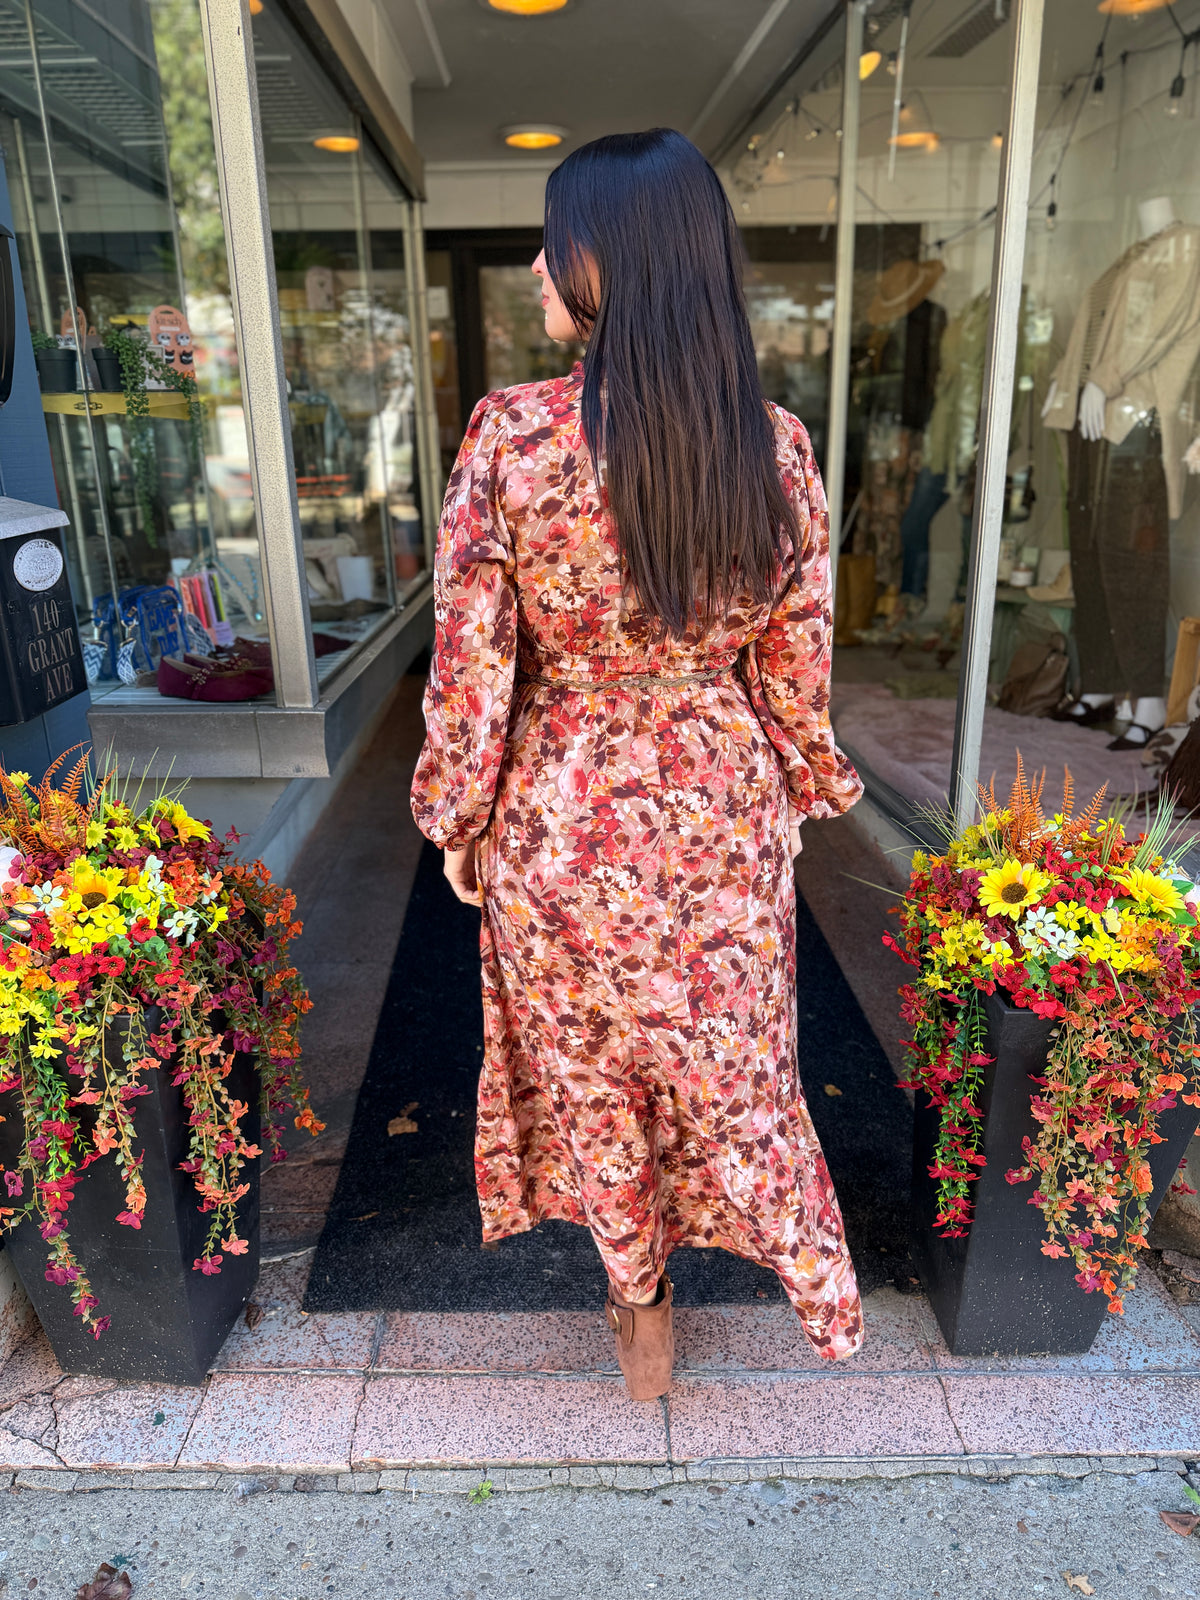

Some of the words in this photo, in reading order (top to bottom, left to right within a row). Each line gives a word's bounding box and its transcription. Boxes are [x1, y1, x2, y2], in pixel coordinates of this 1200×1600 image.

[32, 599, 60, 635] 140
[28, 627, 75, 673] GRANT
[46, 662, 74, 702] AVE
